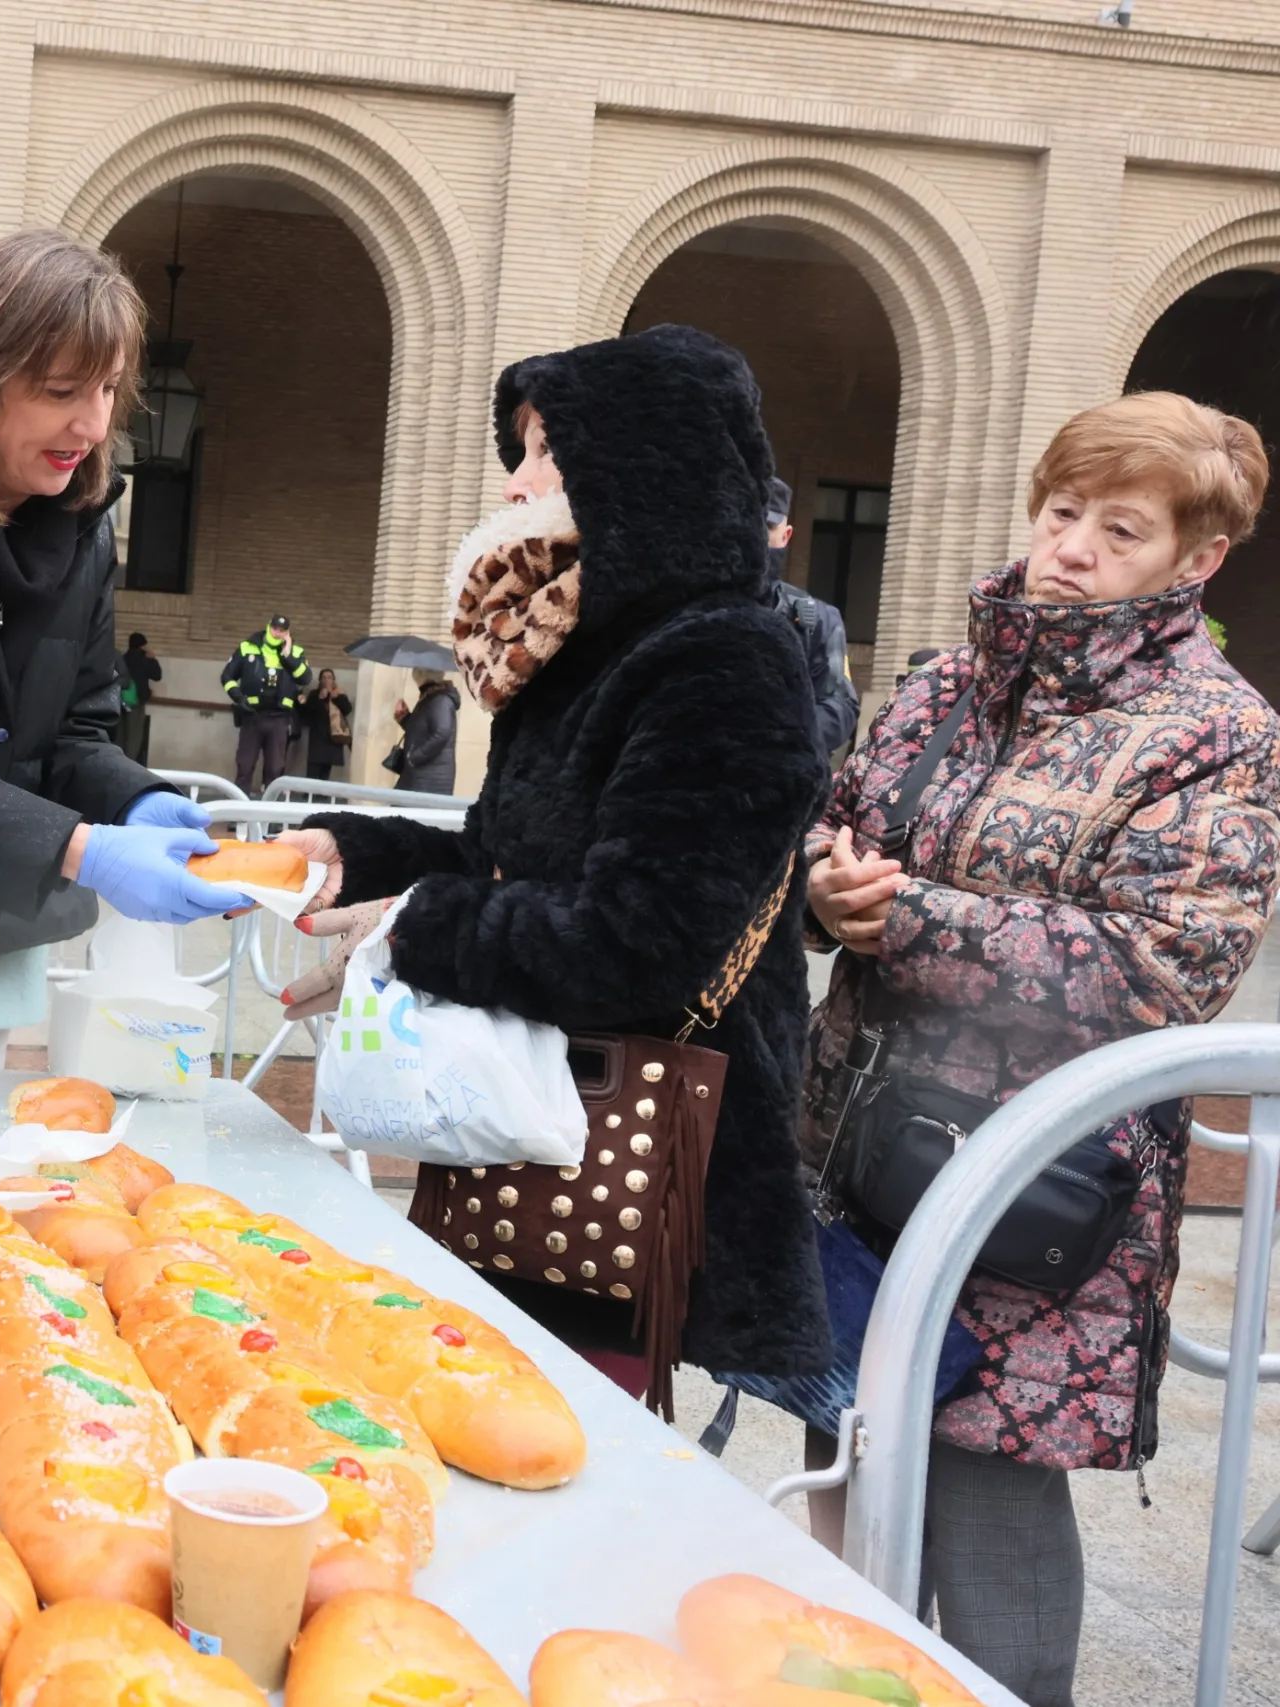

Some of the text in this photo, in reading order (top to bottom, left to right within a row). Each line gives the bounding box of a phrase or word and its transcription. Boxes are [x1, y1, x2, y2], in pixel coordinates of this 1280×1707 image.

[394, 1057, 423, 1070] cru
[360, 1097, 427, 1121] FARMA
[433, 1062, 468, 1094] DE
